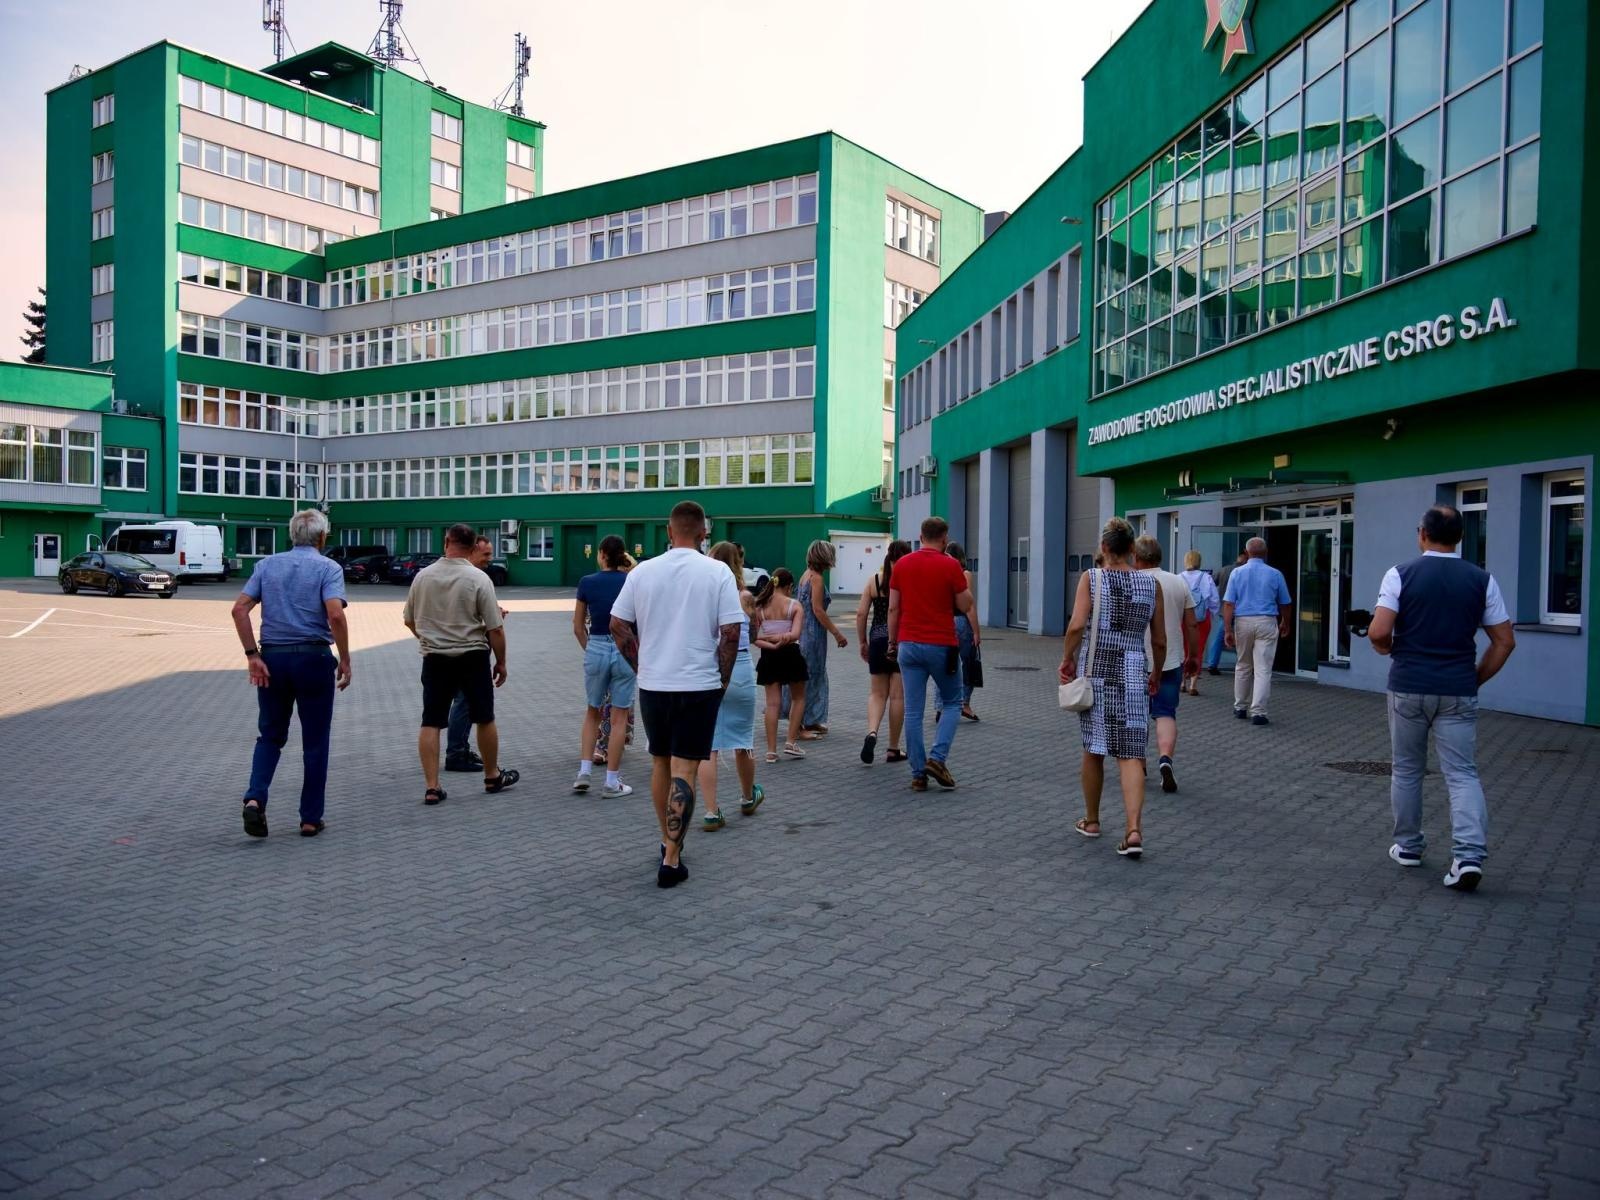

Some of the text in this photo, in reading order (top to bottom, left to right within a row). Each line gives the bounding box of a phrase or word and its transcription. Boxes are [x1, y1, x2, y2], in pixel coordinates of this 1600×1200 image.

[1088, 297, 1517, 446] ZAWODOWE POGOTOWIA SPECJALISTYCZNE CSRG S.A.
